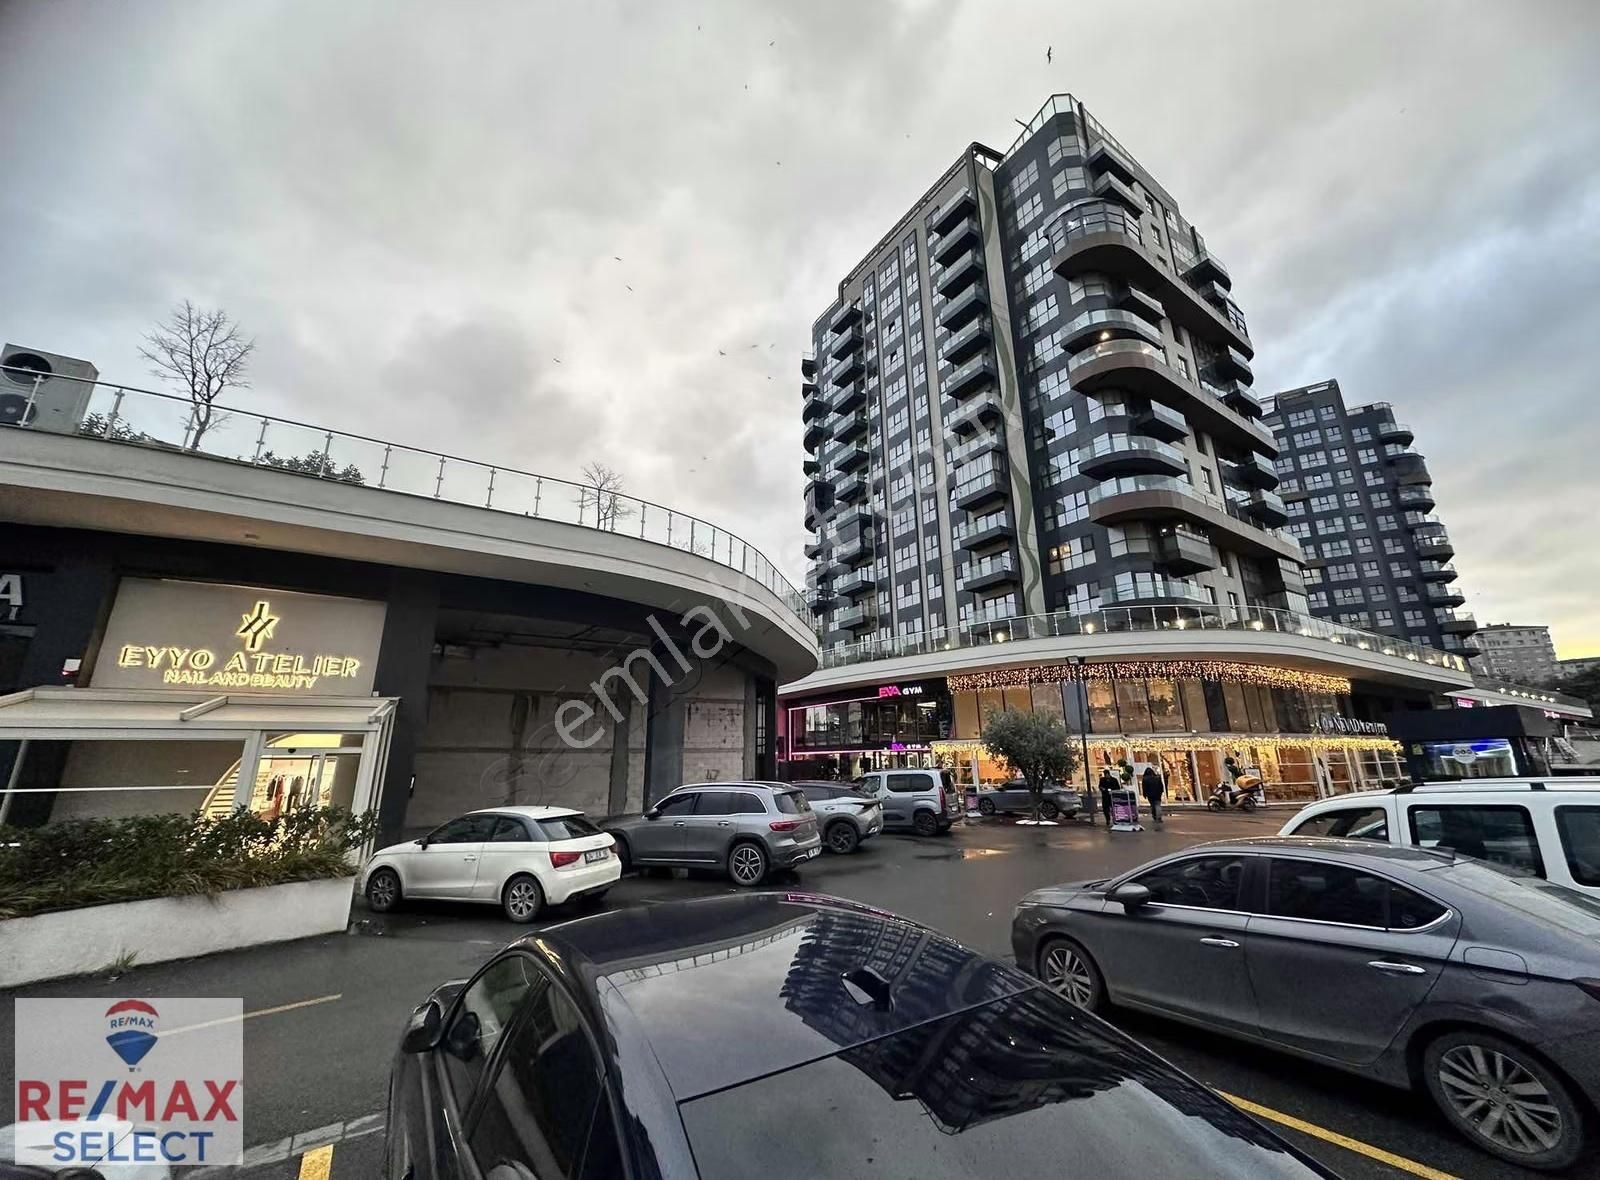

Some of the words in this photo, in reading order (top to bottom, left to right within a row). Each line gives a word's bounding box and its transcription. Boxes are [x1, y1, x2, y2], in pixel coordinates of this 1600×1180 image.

[118, 644, 214, 670] EYYO
[163, 669, 208, 684] NAIL
[878, 685, 901, 697] EVA
[902, 686, 923, 695] GYM
